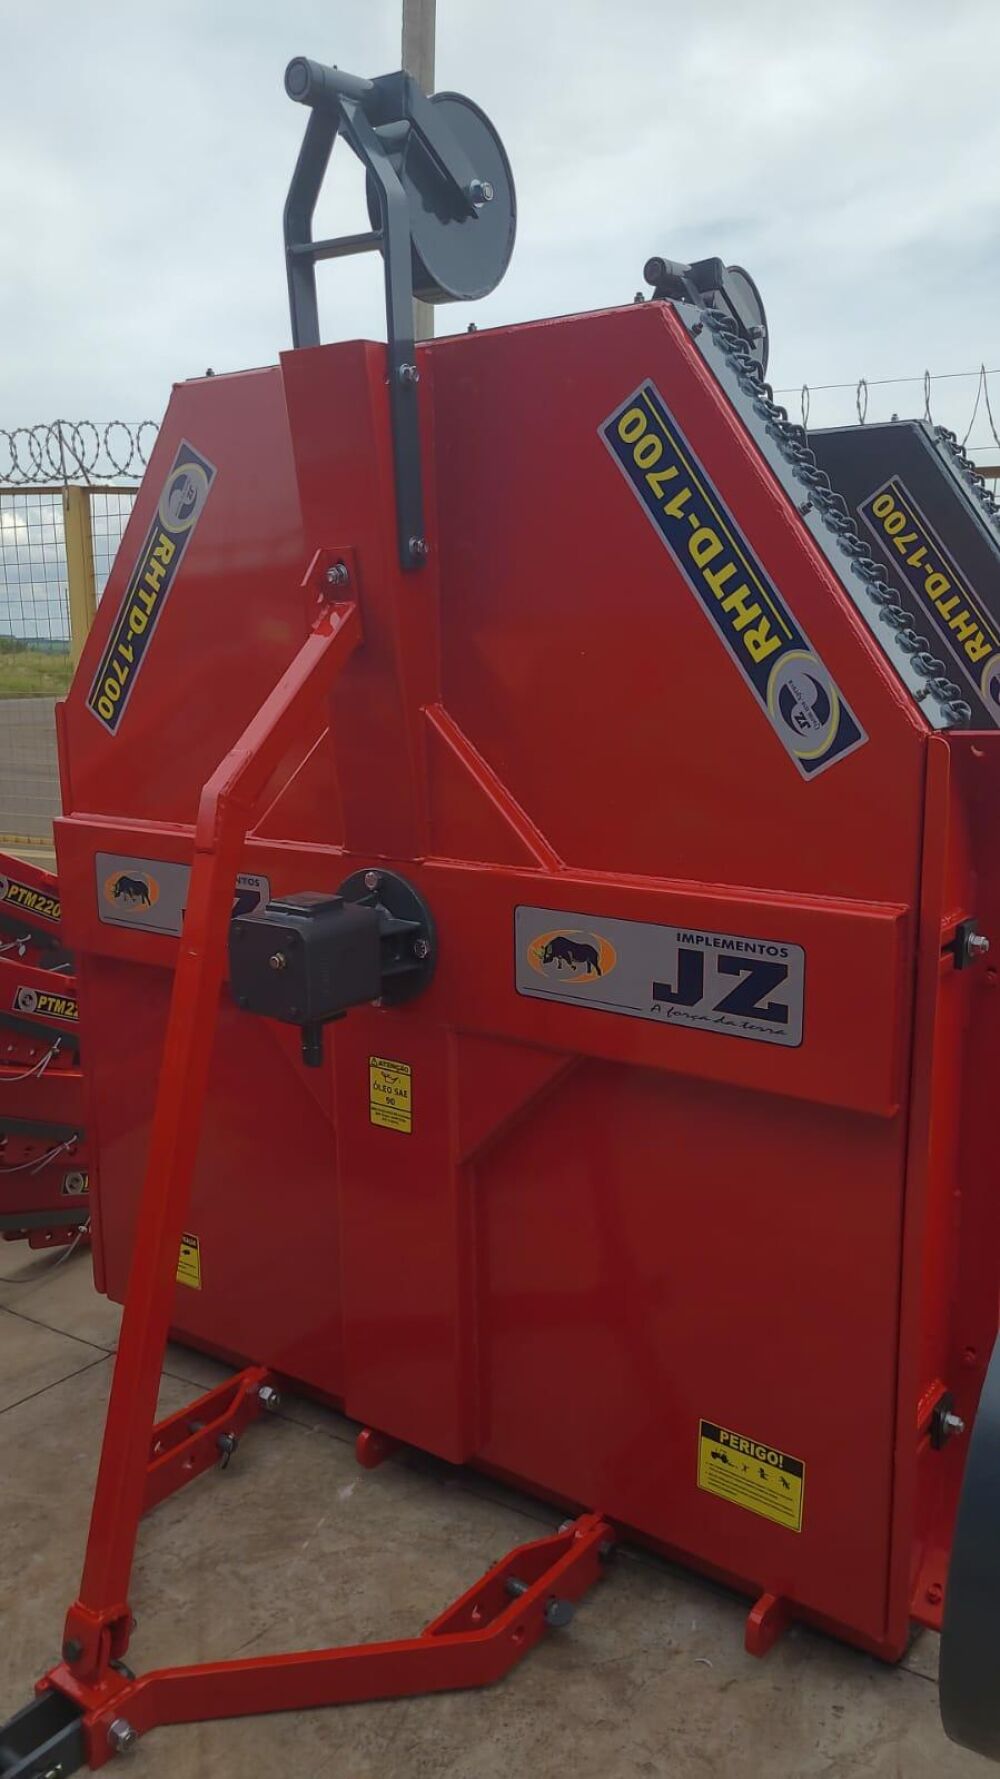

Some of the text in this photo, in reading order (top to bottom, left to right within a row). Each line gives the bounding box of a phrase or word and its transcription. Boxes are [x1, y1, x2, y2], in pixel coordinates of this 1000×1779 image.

[617, 407, 782, 663] RHTD-1700
[872, 494, 992, 663] RHTD-1700
[98, 534, 175, 719] RHTD-1700
[676, 932, 789, 958] IMPLEMENTOS
[650, 1003, 662, 1013] A
[652, 948, 788, 1024] JZ
[394, 1087, 408, 1098] SAE
[719, 1430, 784, 1468] PERIGO!
